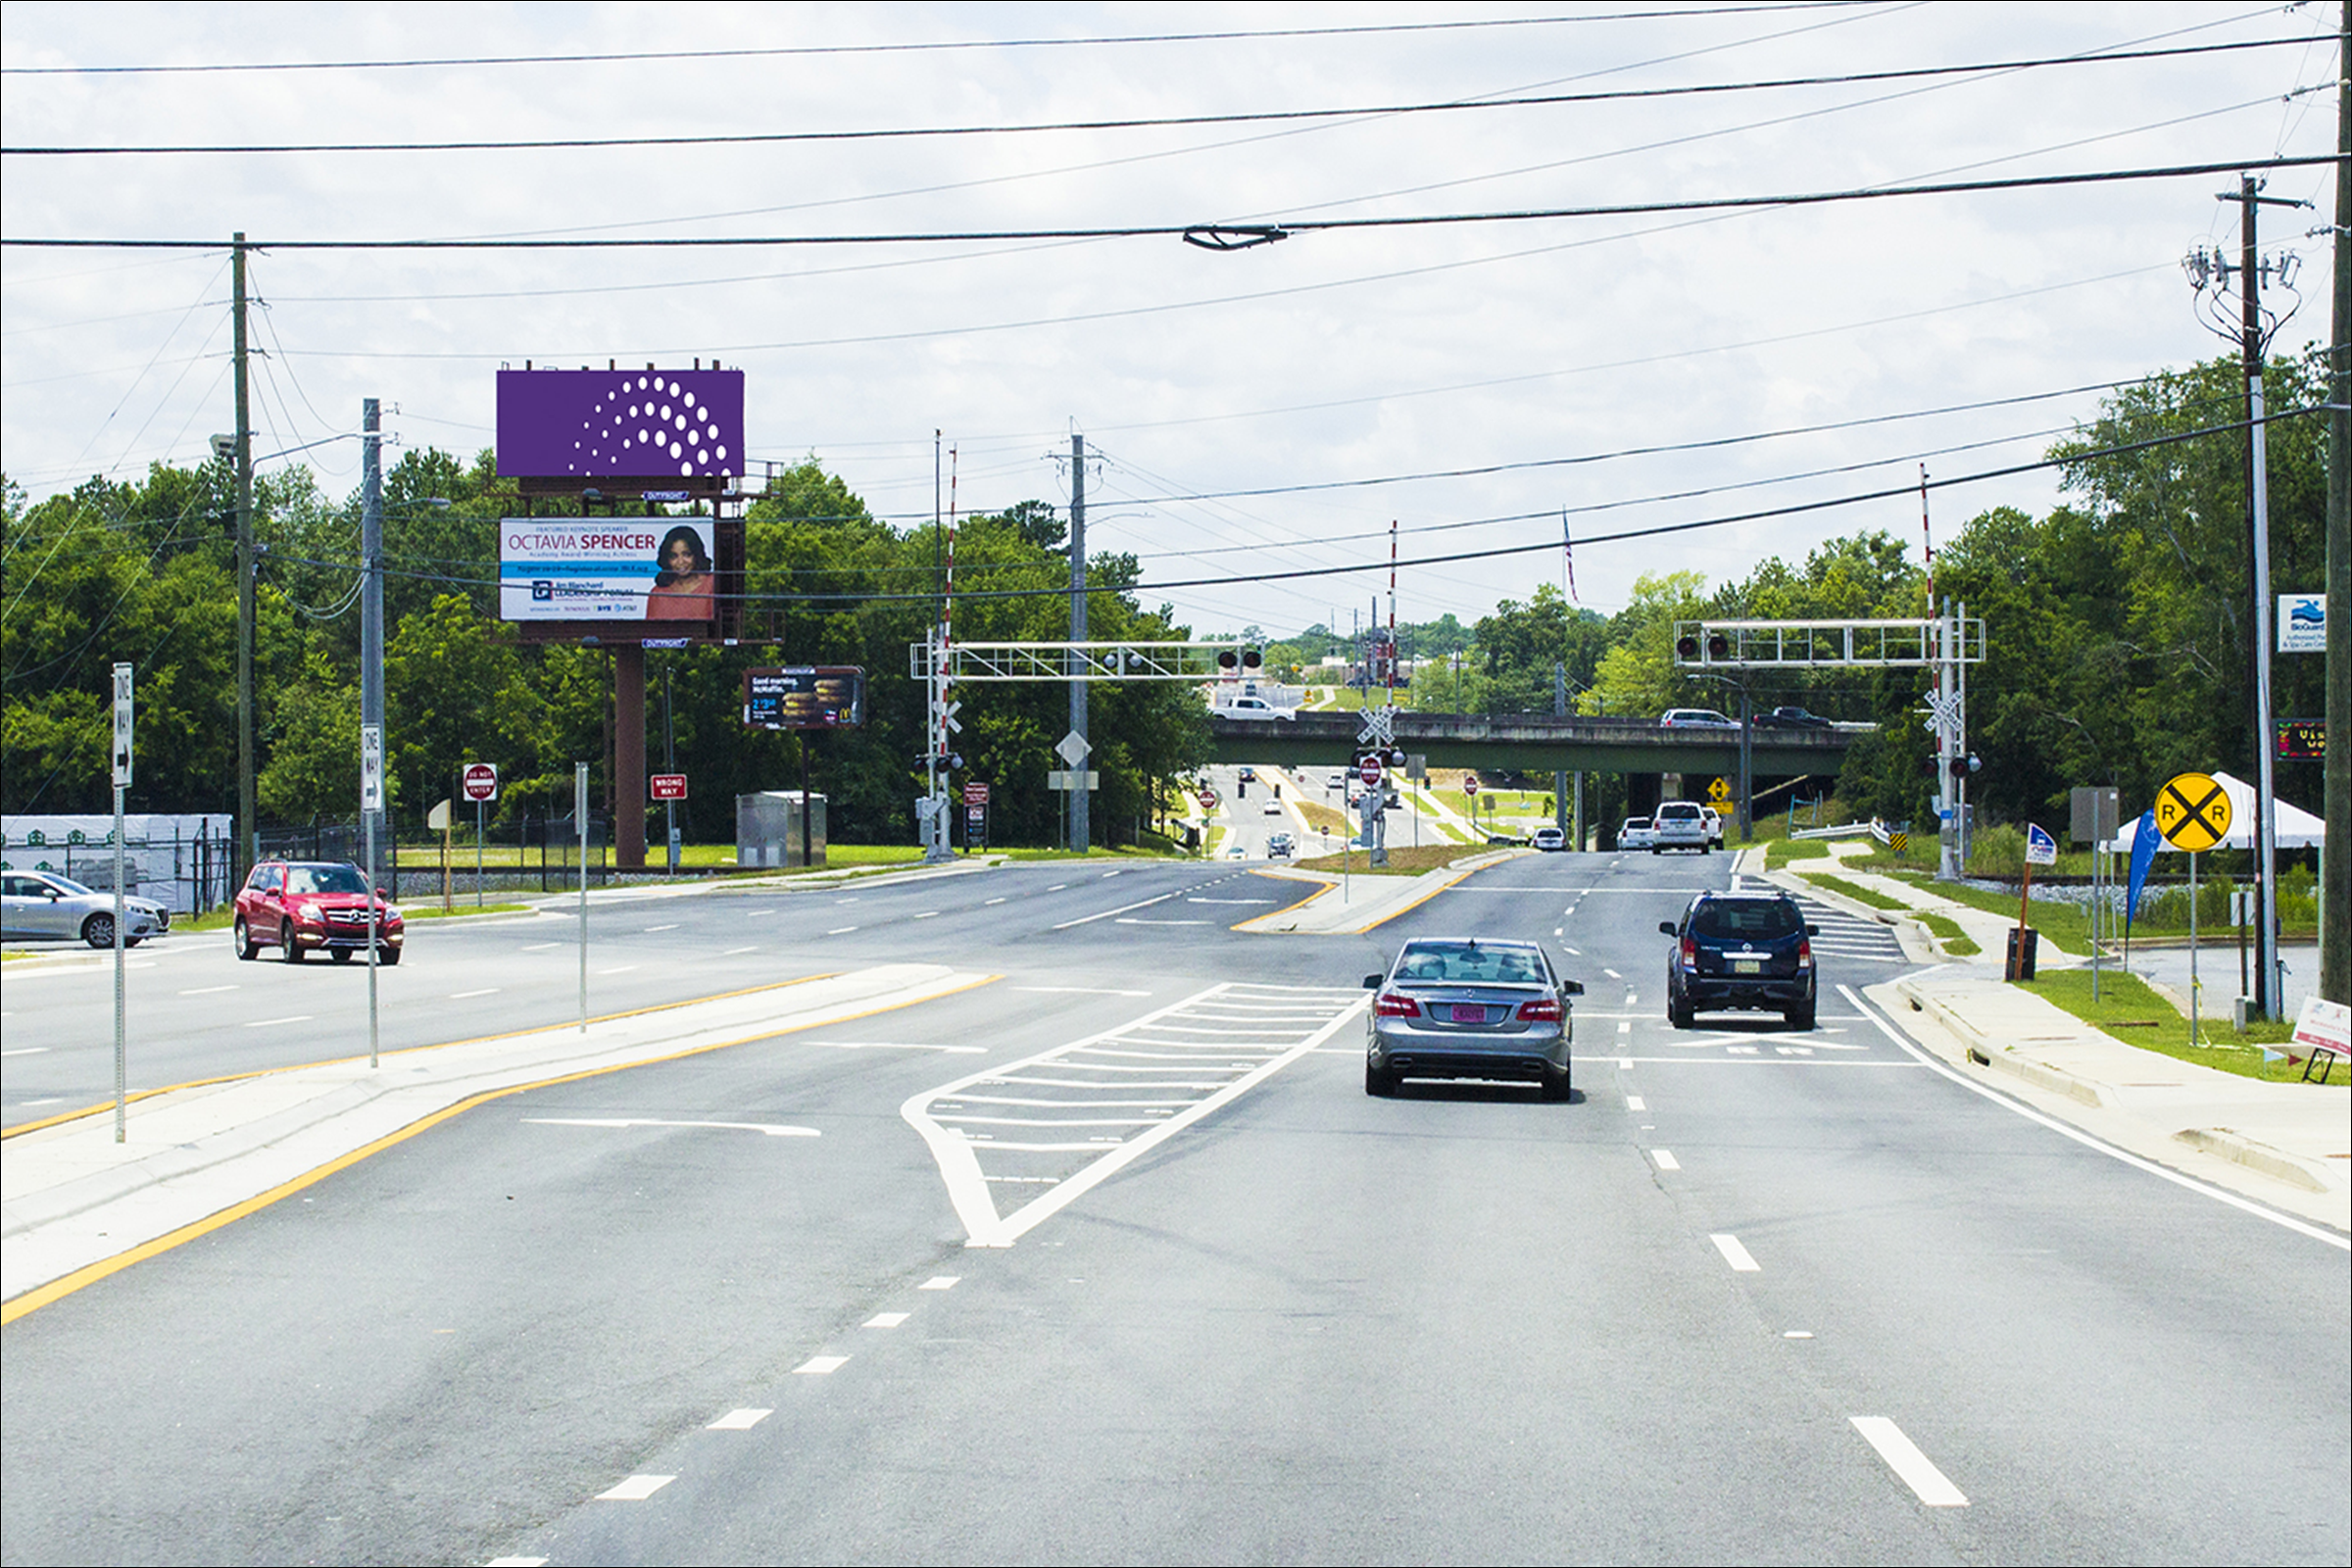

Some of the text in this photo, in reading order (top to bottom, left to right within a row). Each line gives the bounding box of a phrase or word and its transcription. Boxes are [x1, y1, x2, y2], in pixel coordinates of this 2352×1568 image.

[508, 534, 656, 551] OCTAVIA SPENCER
[117, 674, 130, 700] ONE
[117, 710, 130, 735] WAY
[366, 732, 378, 750] ONE
[366, 758, 378, 774] WAY
[656, 778, 683, 787] WRONG
[2162, 805, 2226, 821] R R
